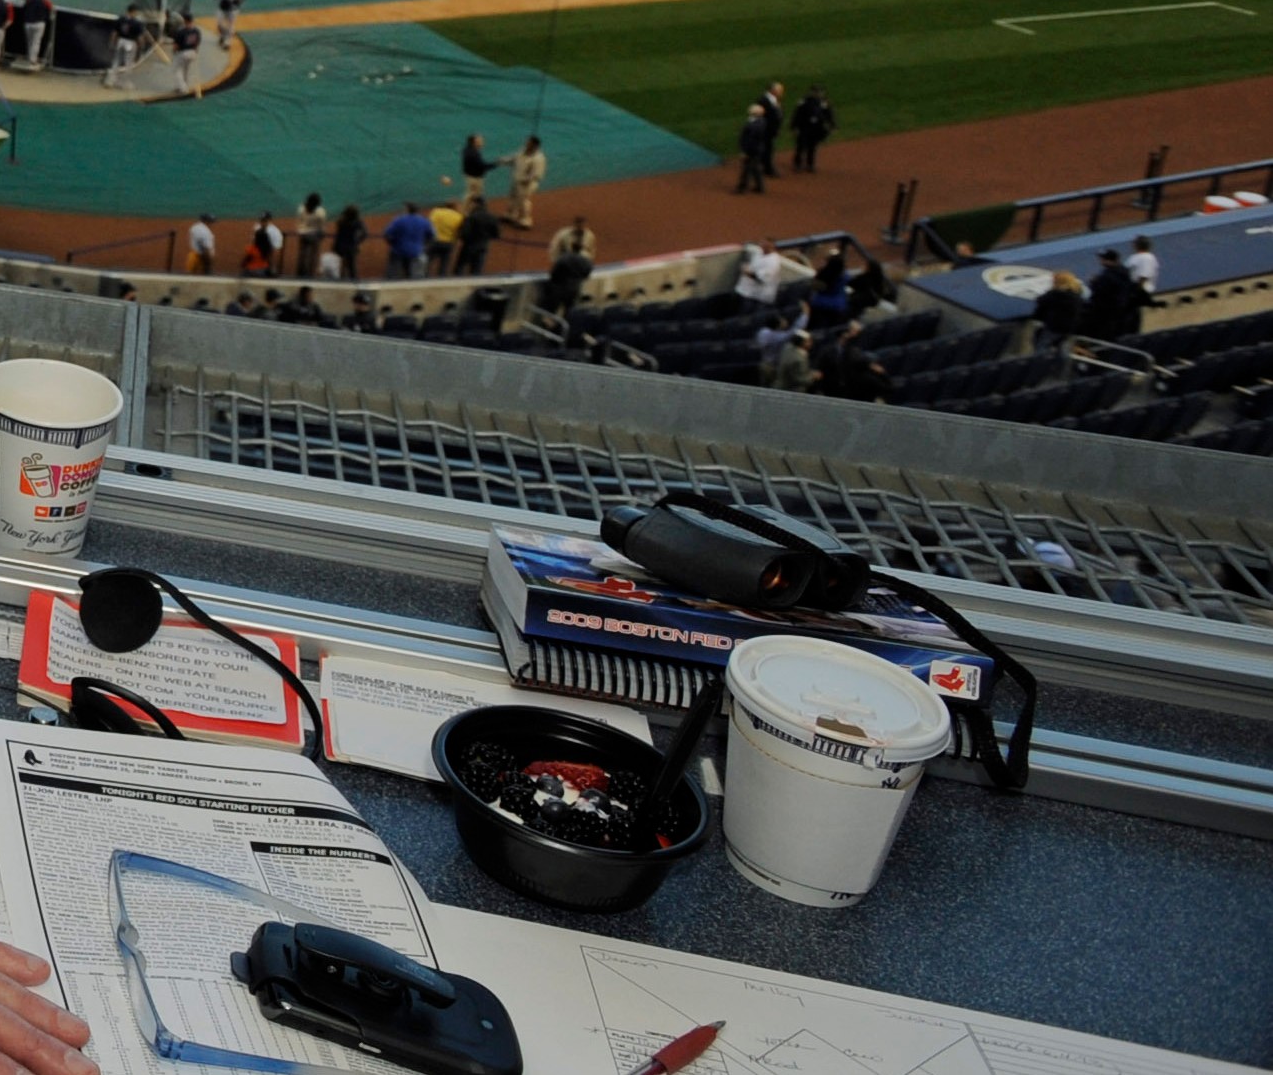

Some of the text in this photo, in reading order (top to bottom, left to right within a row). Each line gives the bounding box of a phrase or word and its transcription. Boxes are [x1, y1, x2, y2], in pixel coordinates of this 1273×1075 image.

[0, 518, 62, 548] New York
[547, 608, 602, 630] 2009
[604, 618, 690, 643] BOSTON
[690, 631, 733, 650] RED
[51, 635, 217, 679] MERCEDES-BENZ TRI-STATE
[52, 625, 81, 643] GAME
[193, 657, 210, 667] BY
[213, 659, 249, 673] YOUR
[177, 642, 210, 655] KEYS
[213, 647, 231, 658] TO
[49, 646, 267, 700] DEALERS ON THE WEB AT SEARCH
[116, 677, 141, 689] DOT
[184, 691, 221, 704] YOUR
[223, 696, 278, 714] SOURCE
[55, 788, 93, 802] LESTER,
[100, 786, 296, 816] TONIGHT'S RED SOX STARTING PITCHER
[269, 844, 377, 861] INSIDE THE NUMBERS
